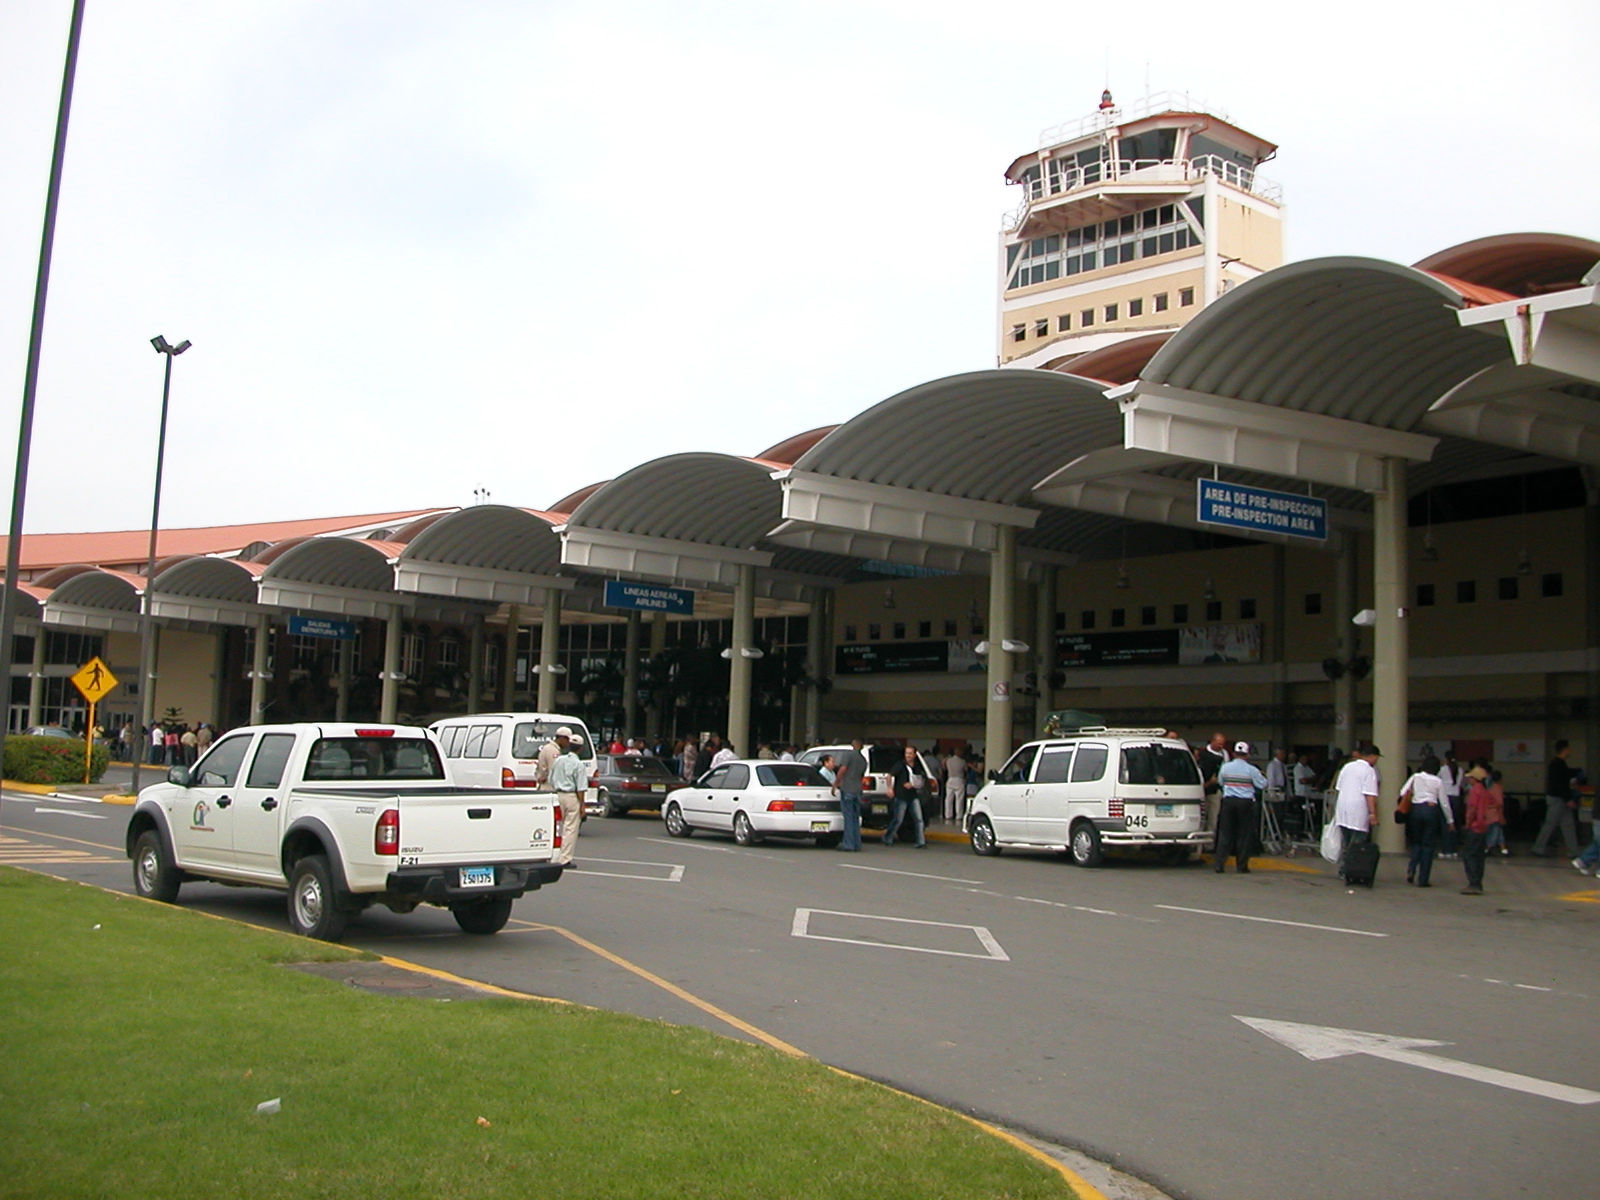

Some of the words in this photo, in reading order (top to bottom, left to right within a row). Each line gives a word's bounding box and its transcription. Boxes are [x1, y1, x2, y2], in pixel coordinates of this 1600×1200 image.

[1205, 487, 1232, 502] AREA
[1233, 492, 1247, 505] DE
[1248, 495, 1323, 517] PRE-INSPECCION
[1212, 504, 1289, 527] PRE-INSPECTION
[1291, 517, 1315, 531] AREA
[624, 587, 649, 597] LINEAS
[650, 590, 678, 600] AEREAS
[636, 598, 667, 608] AIRLINES
[1125, 815, 1148, 827] 046
[401, 856, 418, 865] F-21
